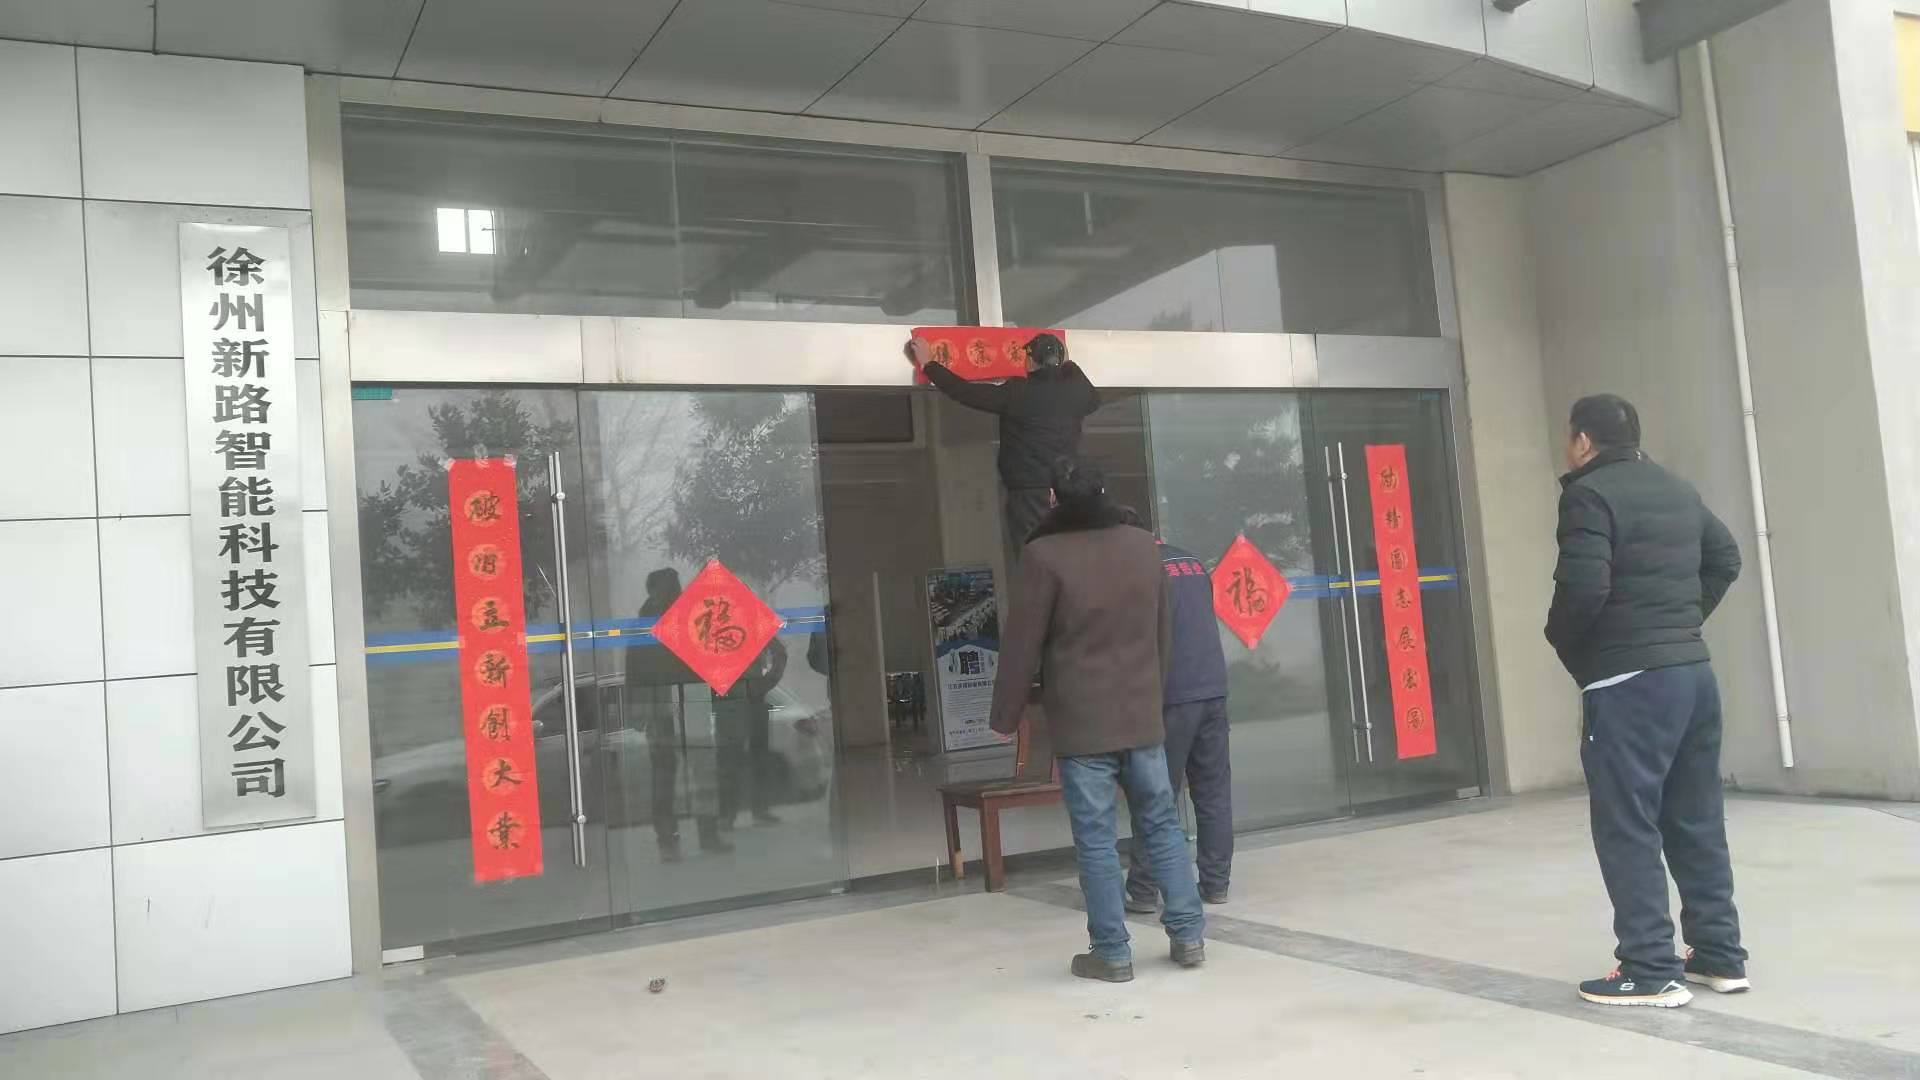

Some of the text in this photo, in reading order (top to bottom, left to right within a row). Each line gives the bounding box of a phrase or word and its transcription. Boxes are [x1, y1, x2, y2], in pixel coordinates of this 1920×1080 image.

[206, 246, 286, 798] 徐州新路智能科技有限公司
[1226, 567, 1266, 616] 福
[694, 597, 746, 653] 福
